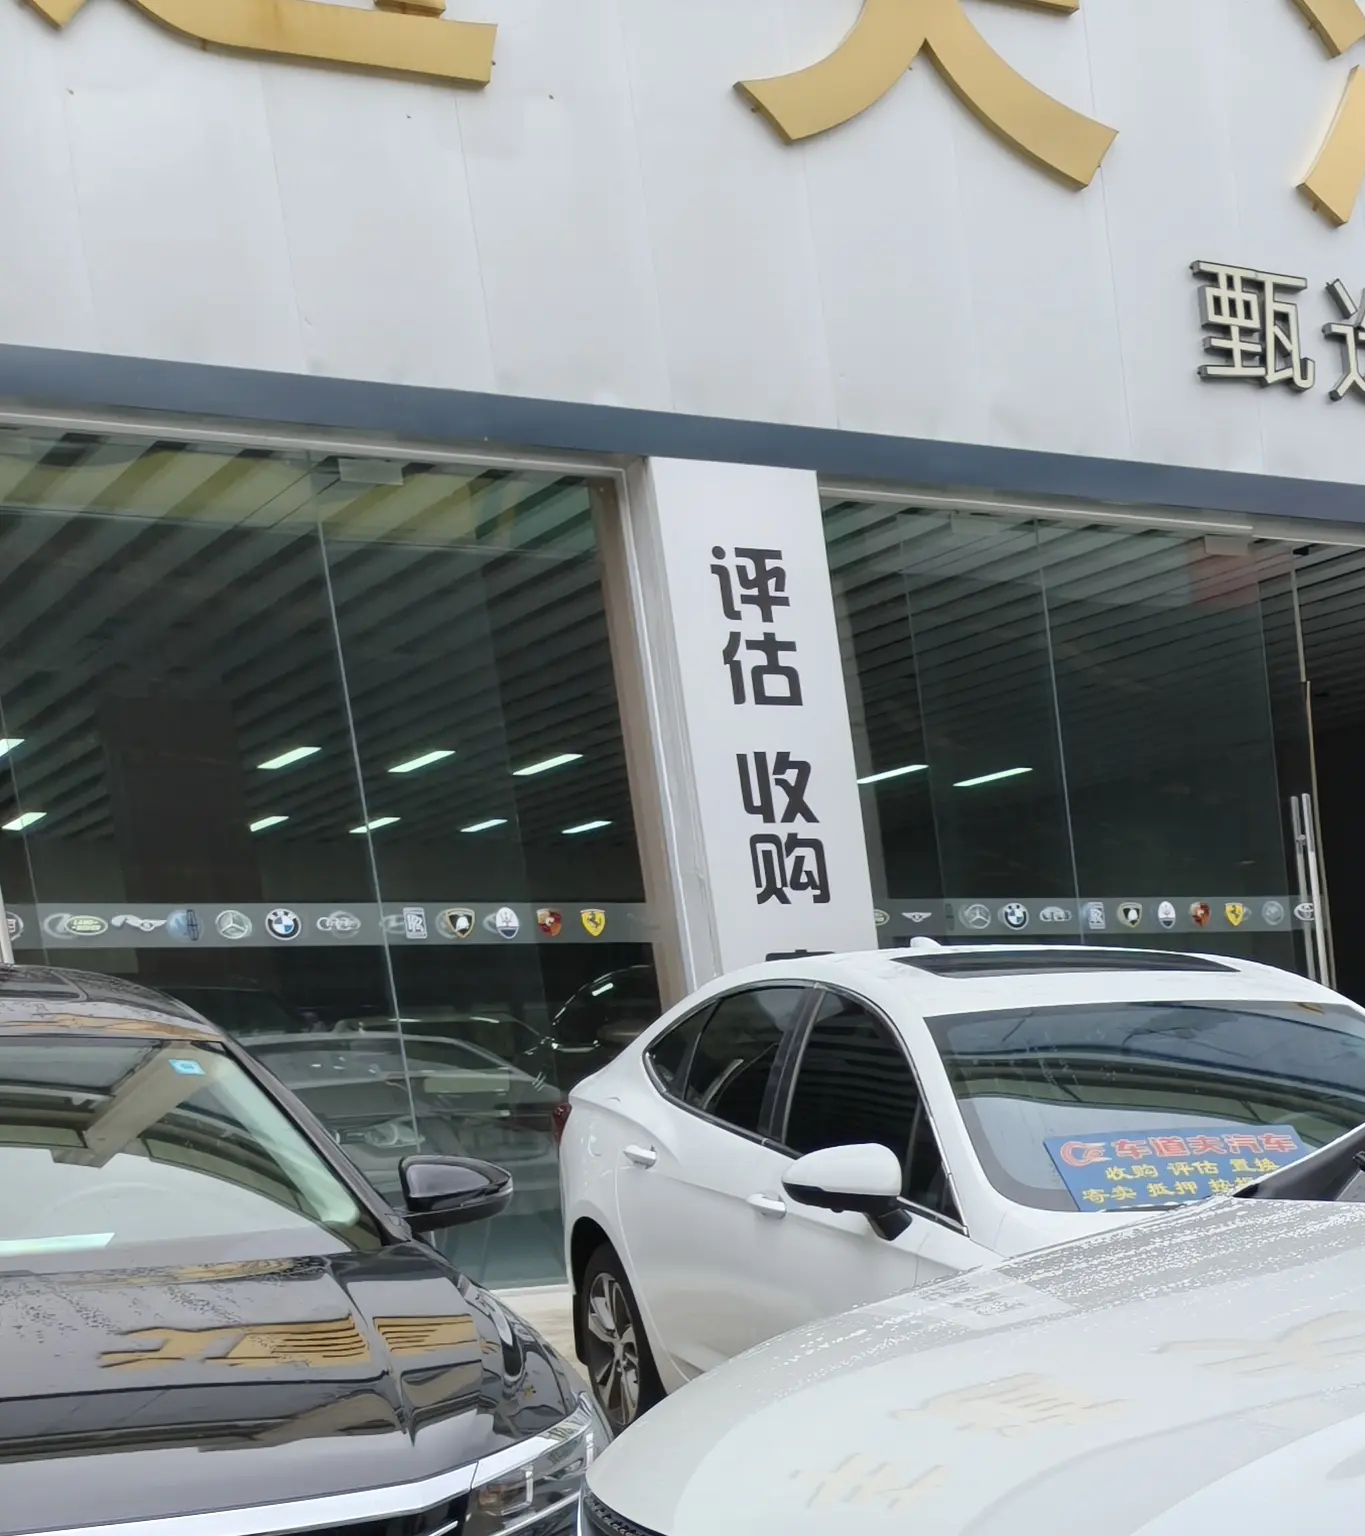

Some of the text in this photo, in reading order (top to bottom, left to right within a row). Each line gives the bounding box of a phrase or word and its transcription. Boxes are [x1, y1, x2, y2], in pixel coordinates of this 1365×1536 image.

[1111, 1133, 1299, 1160] 车道夫汽车
